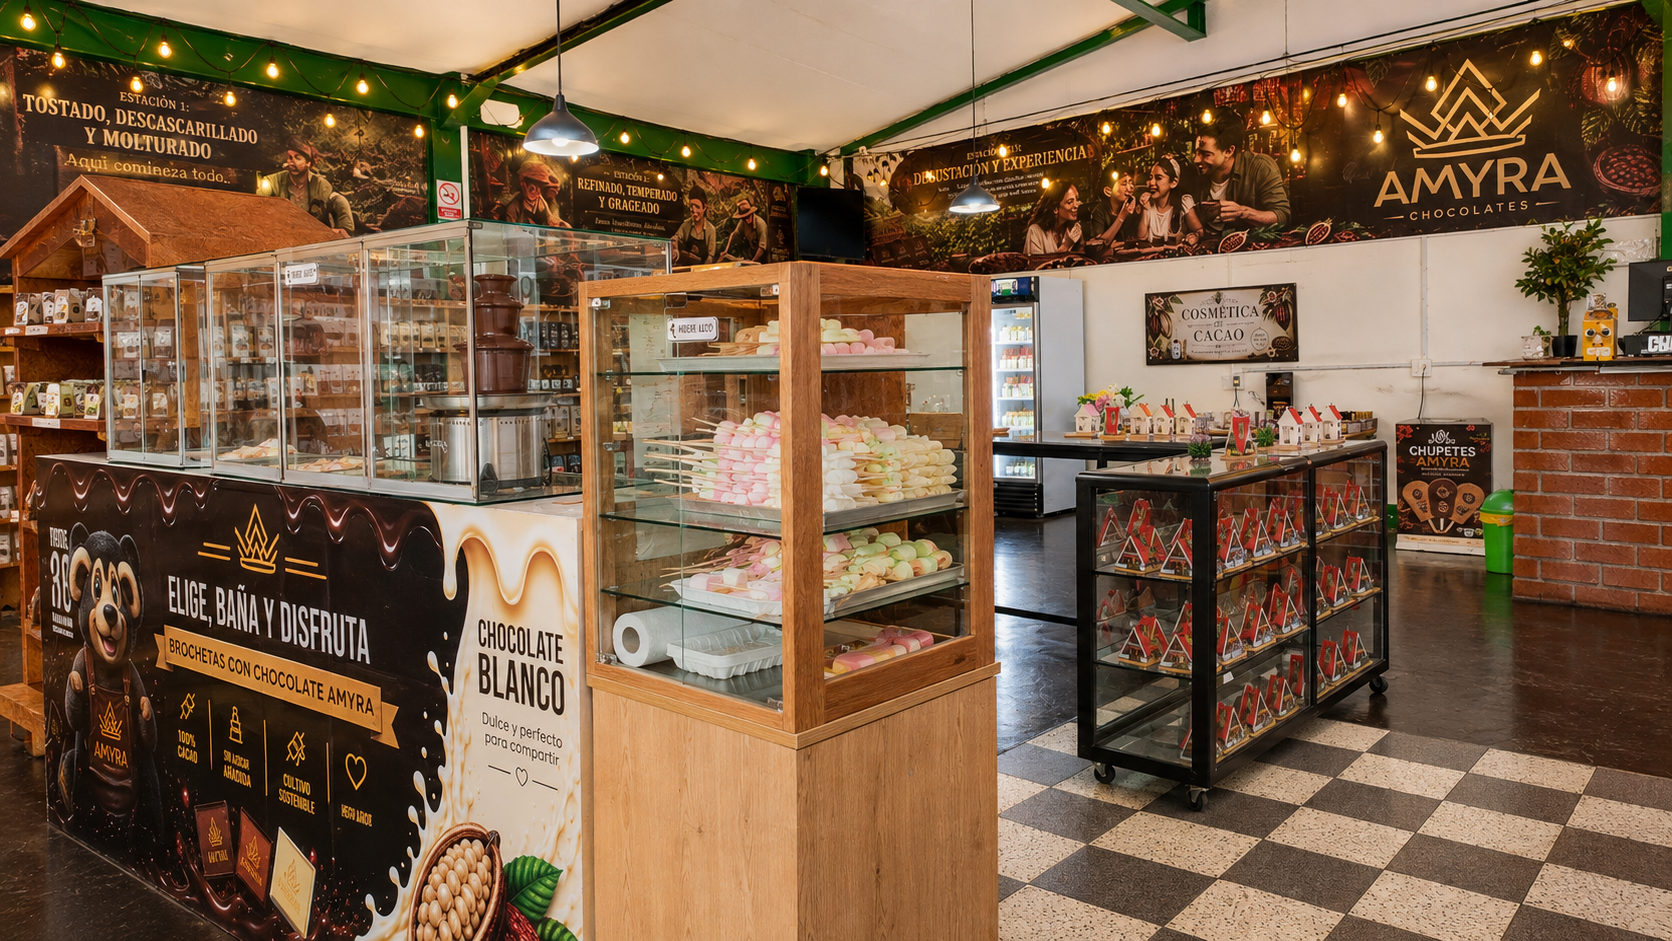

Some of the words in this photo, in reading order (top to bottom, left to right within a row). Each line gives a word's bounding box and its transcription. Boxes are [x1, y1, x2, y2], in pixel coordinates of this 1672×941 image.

[22, 93, 110, 125] TOSTADO,
[115, 108, 259, 144] DESCASCARILLADO
[180, 101, 190, 113] 1:
[84, 126, 97, 145] Y
[103, 128, 212, 160] MOLTURADO
[992, 160, 1001, 174] Y
[1003, 145, 1087, 172] EXPERIENCIA
[577, 177, 626, 196] REFINADO,
[626, 184, 678, 202] TEMPERADO
[1373, 152, 1572, 208] AMYRA
[598, 196, 606, 209] Y
[608, 197, 660, 215] GRAGEADO
[1409, 200, 1529, 221] CHOCOLATES
[1193, 328, 1244, 342] CACAO
[1409, 445, 1476, 457] CHUPETES
[1416, 456, 1470, 468] AMYRA
[168, 575, 212, 628] ELIGE,
[216, 584, 260, 636] BAÑA
[263, 597, 275, 639] Y
[280, 601, 371, 665] DISFRUTA
[478, 618, 564, 665] CHOCOLATE
[169, 638, 226, 669] BROCHETAS
[227, 656, 251, 678] CON
[253, 664, 324, 701] CHOCOLATE
[327, 686, 375, 716] AMYRA
[478, 652, 565, 716] BLANCO
[178, 729, 196, 748] 100%
[481, 711, 510, 732] Dulce
[511, 722, 518, 737] y
[520, 725, 563, 749] perfecto
[94, 740, 129, 769] AMYRA
[484, 732, 508, 750] para
[509, 739, 560, 767] compartir
[282, 773, 311, 796] CULTIVO
